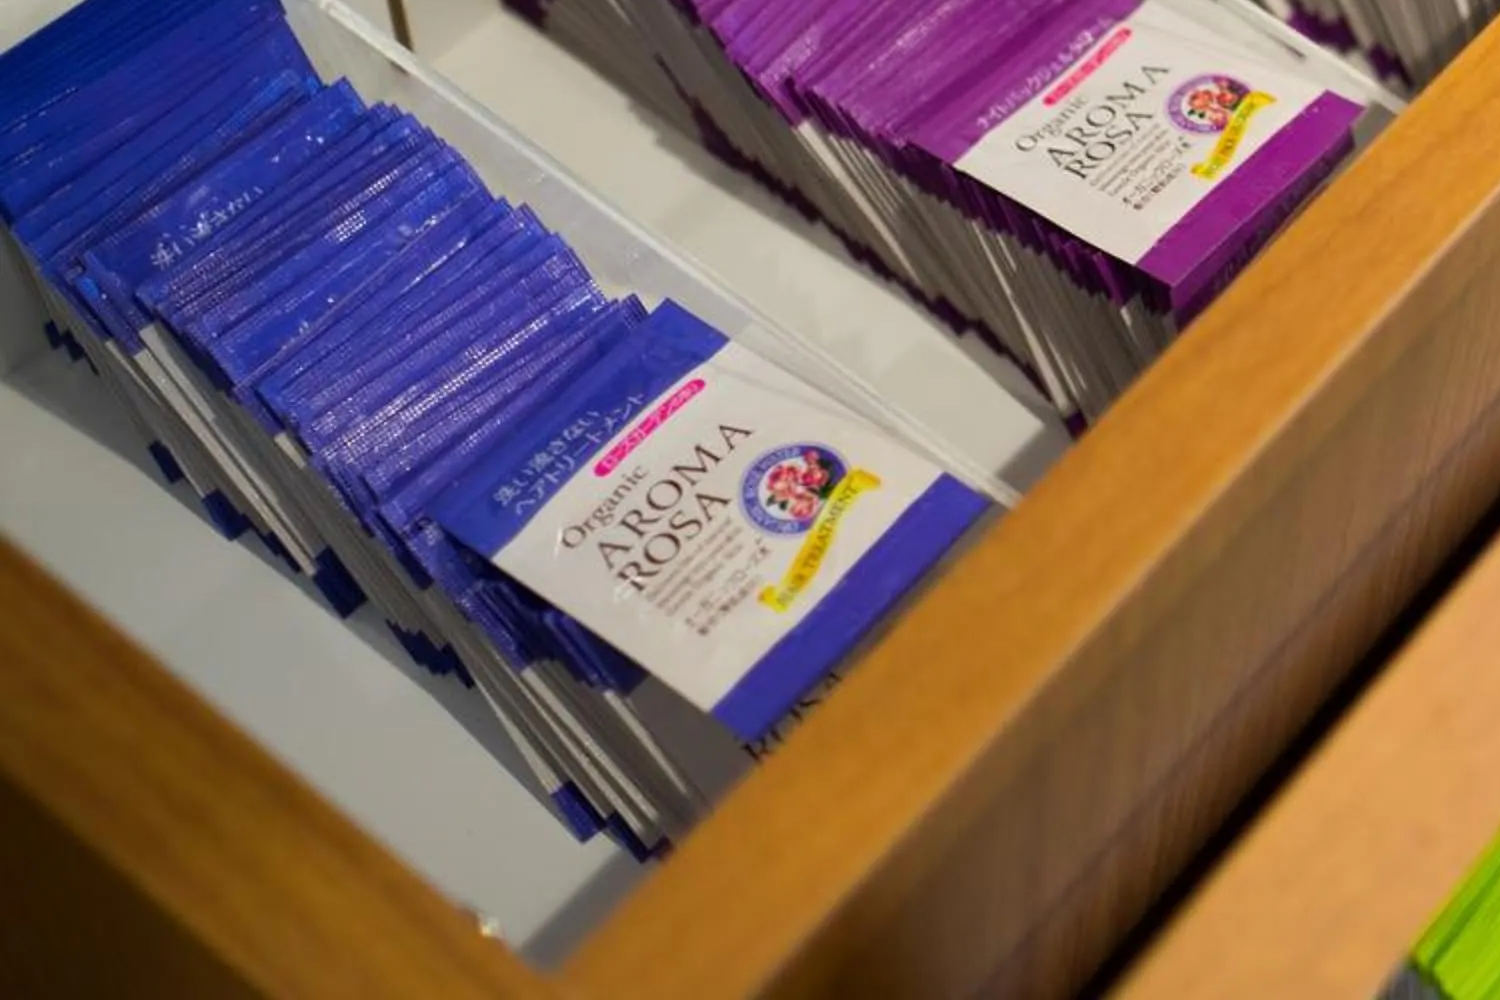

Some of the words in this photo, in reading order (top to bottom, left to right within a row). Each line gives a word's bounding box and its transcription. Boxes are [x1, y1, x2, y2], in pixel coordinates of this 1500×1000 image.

[1015, 94, 1089, 152] Organic
[1047, 65, 1170, 168] AROMA
[1064, 112, 1153, 180] ROSA
[493, 410, 600, 507] 洗い流さない
[515, 393, 644, 515] ヘアトリートメント
[597, 424, 753, 570] AROMA
[561, 464, 649, 549] Organic
[617, 492, 732, 592] ROSA
